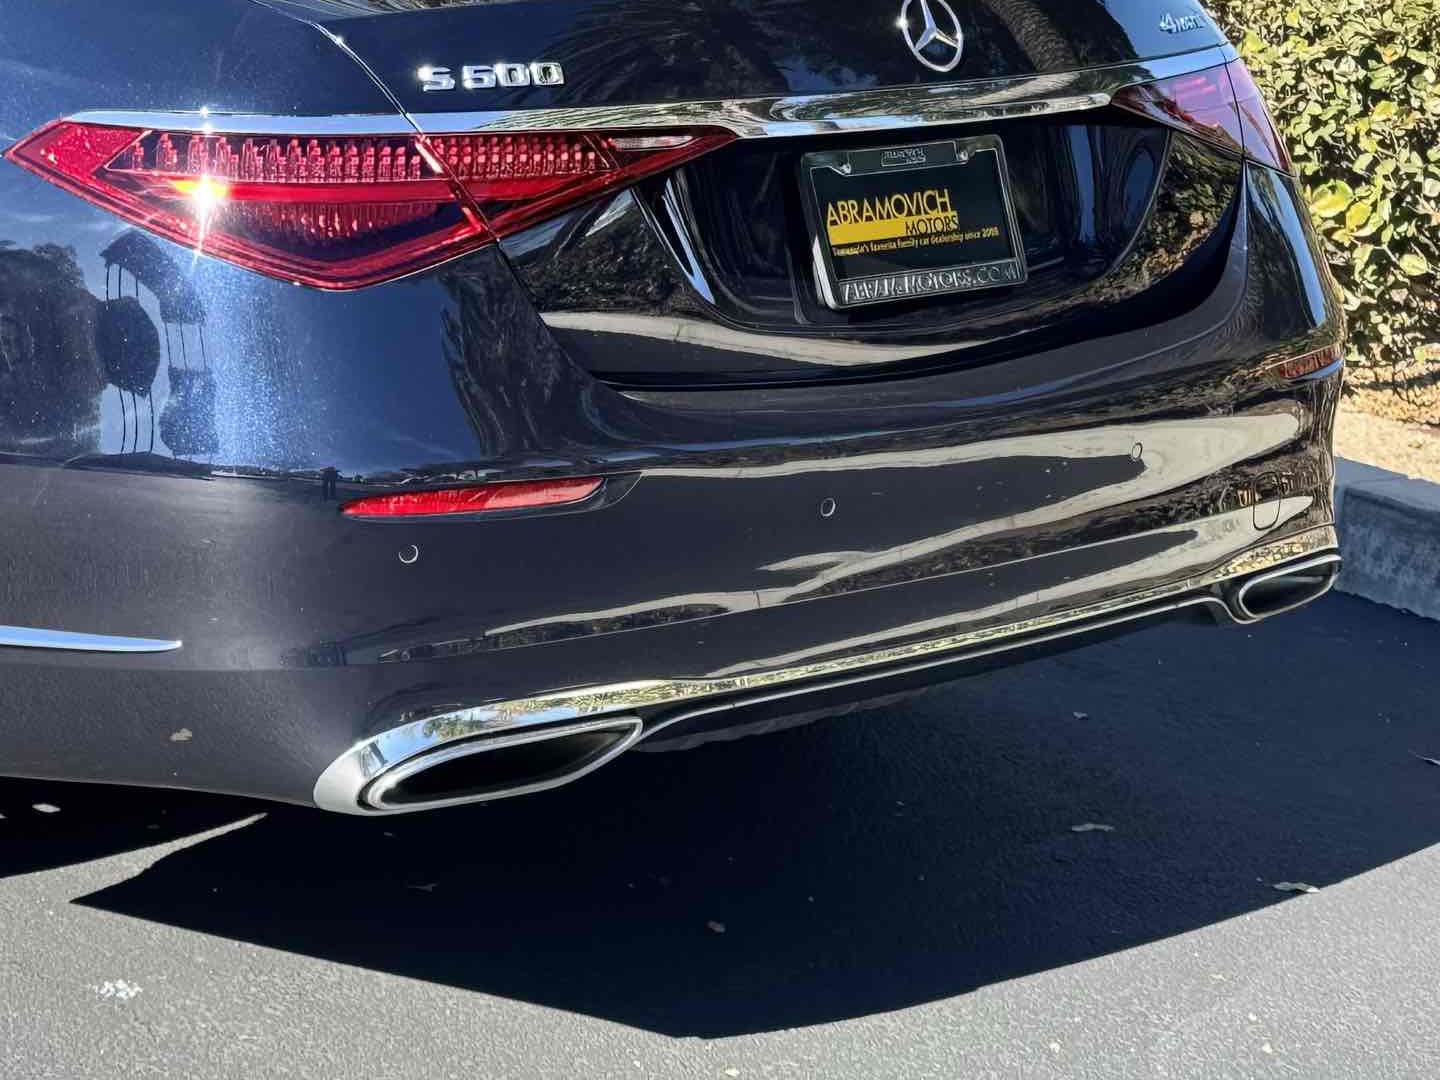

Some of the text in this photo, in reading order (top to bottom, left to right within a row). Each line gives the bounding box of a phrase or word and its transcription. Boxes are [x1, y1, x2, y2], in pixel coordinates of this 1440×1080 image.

[417, 65, 456, 92] S
[826, 189, 951, 226] ABRAMOVICH
[905, 214, 960, 235] MOTORS
